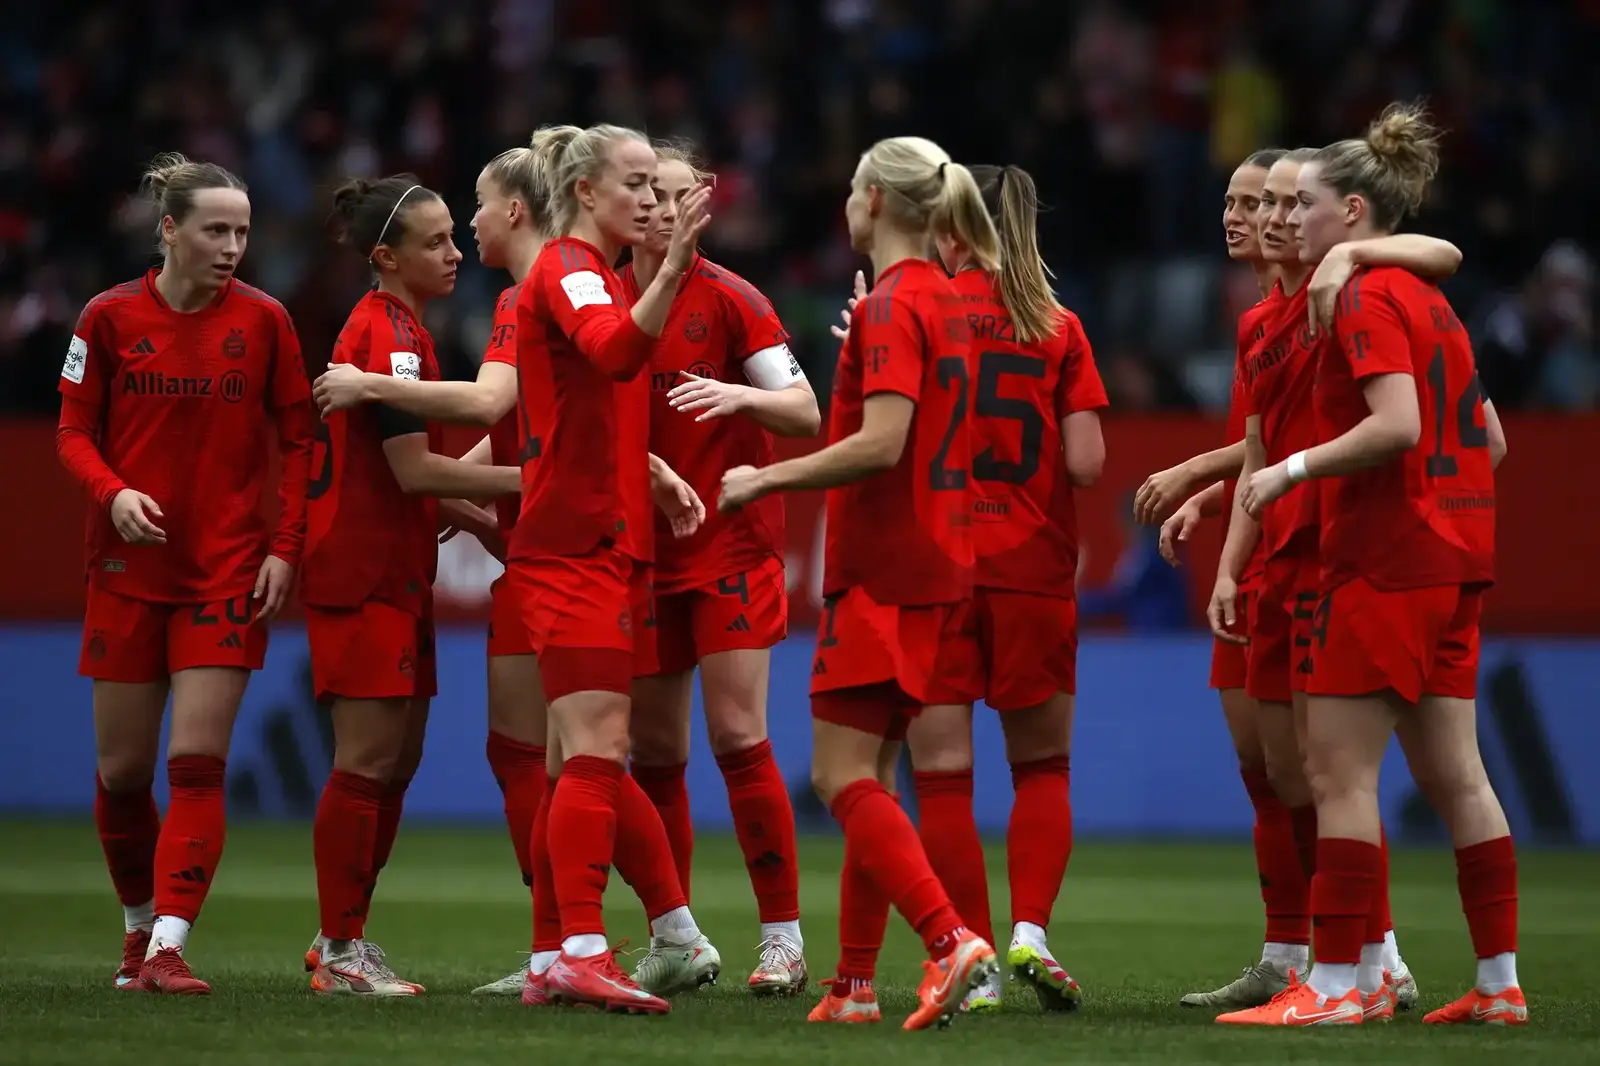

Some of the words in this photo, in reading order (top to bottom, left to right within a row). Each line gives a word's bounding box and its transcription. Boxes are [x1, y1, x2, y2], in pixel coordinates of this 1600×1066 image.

[122, 373, 213, 396] Allianz
[718, 573, 748, 604] 4
[192, 593, 253, 625] 20
